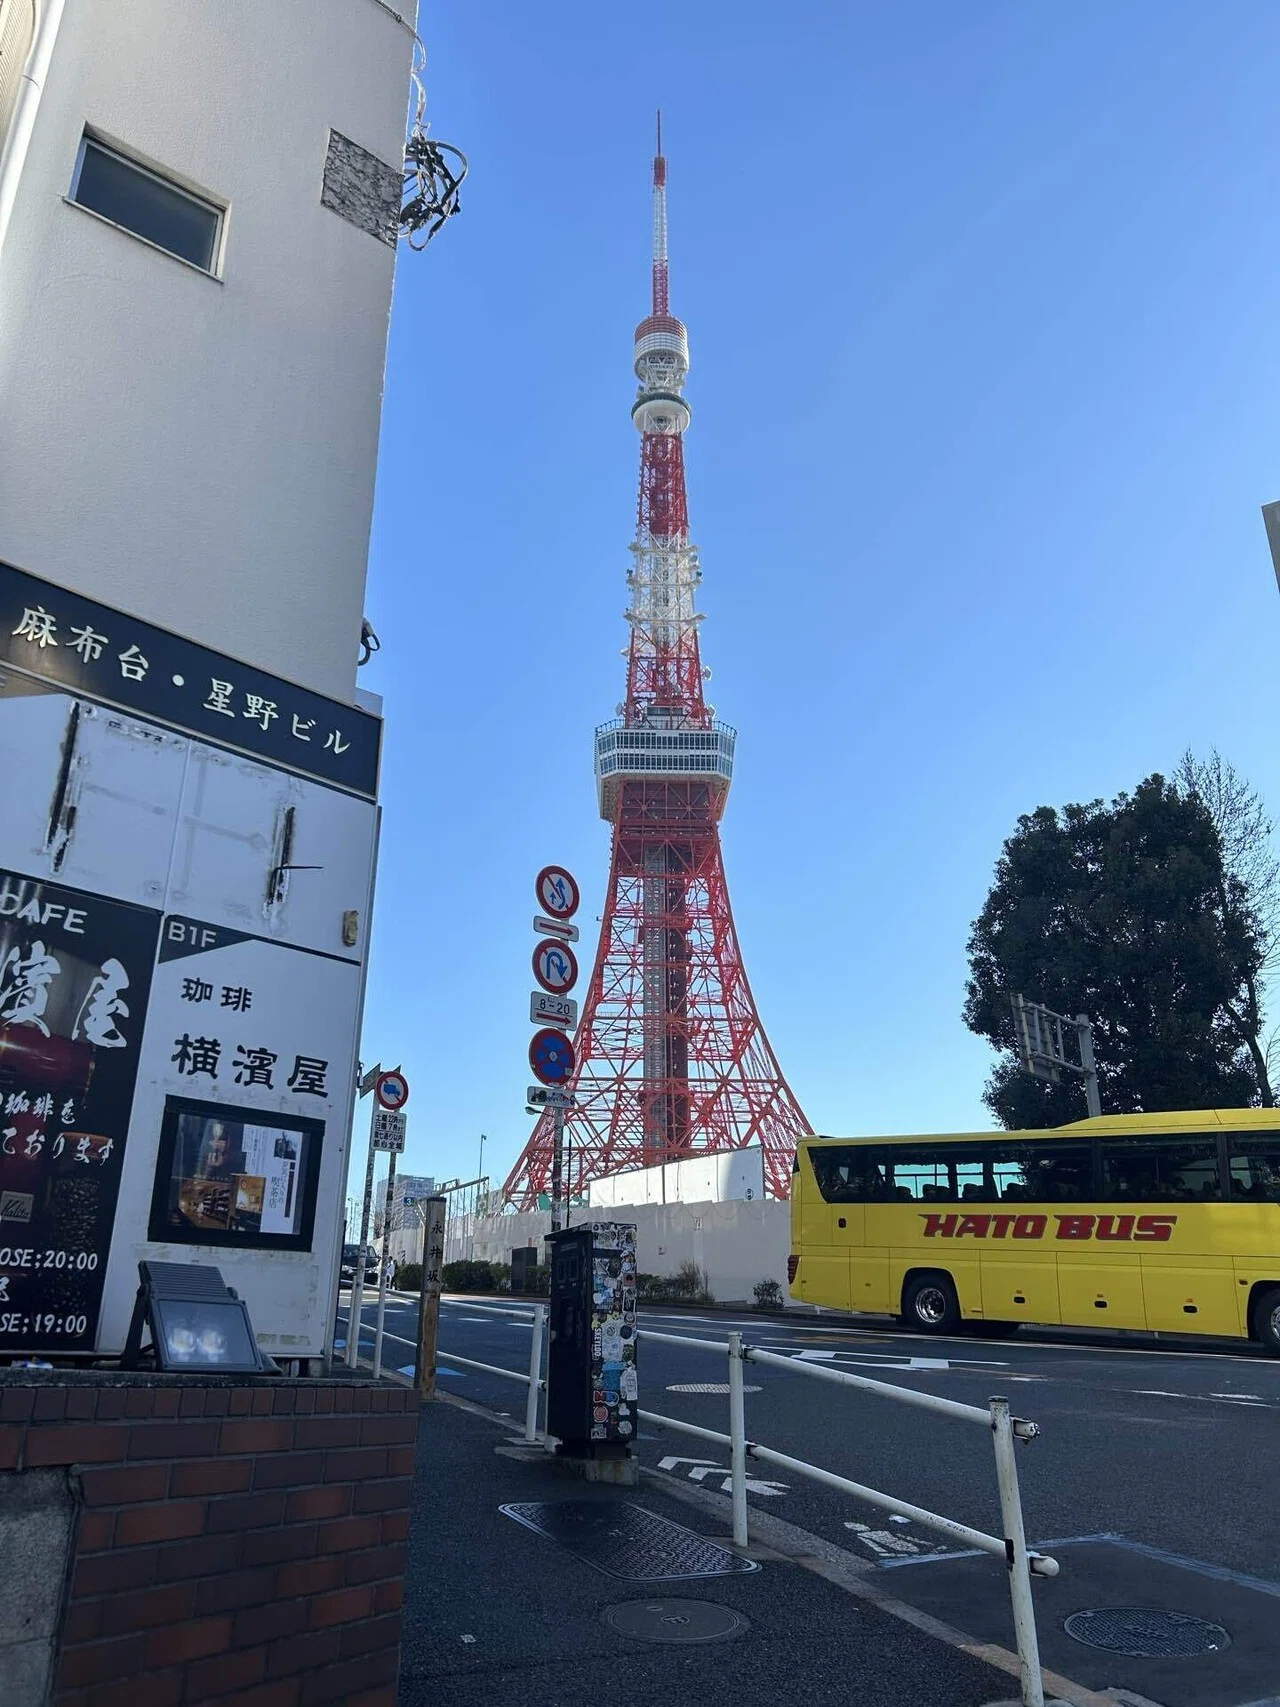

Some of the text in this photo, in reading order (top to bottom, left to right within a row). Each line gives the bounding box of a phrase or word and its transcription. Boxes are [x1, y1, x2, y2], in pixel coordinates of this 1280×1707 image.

[11, 605, 353, 756] 麻布台・星野ビル
[167, 921, 217, 948] B1F
[181, 977, 253, 1013] 珈琲
[171, 1033, 329, 1098] 横濱屋
[918, 1212, 1178, 1242] HATO BUS
[427, 1223, 443, 1284] 永井坂
